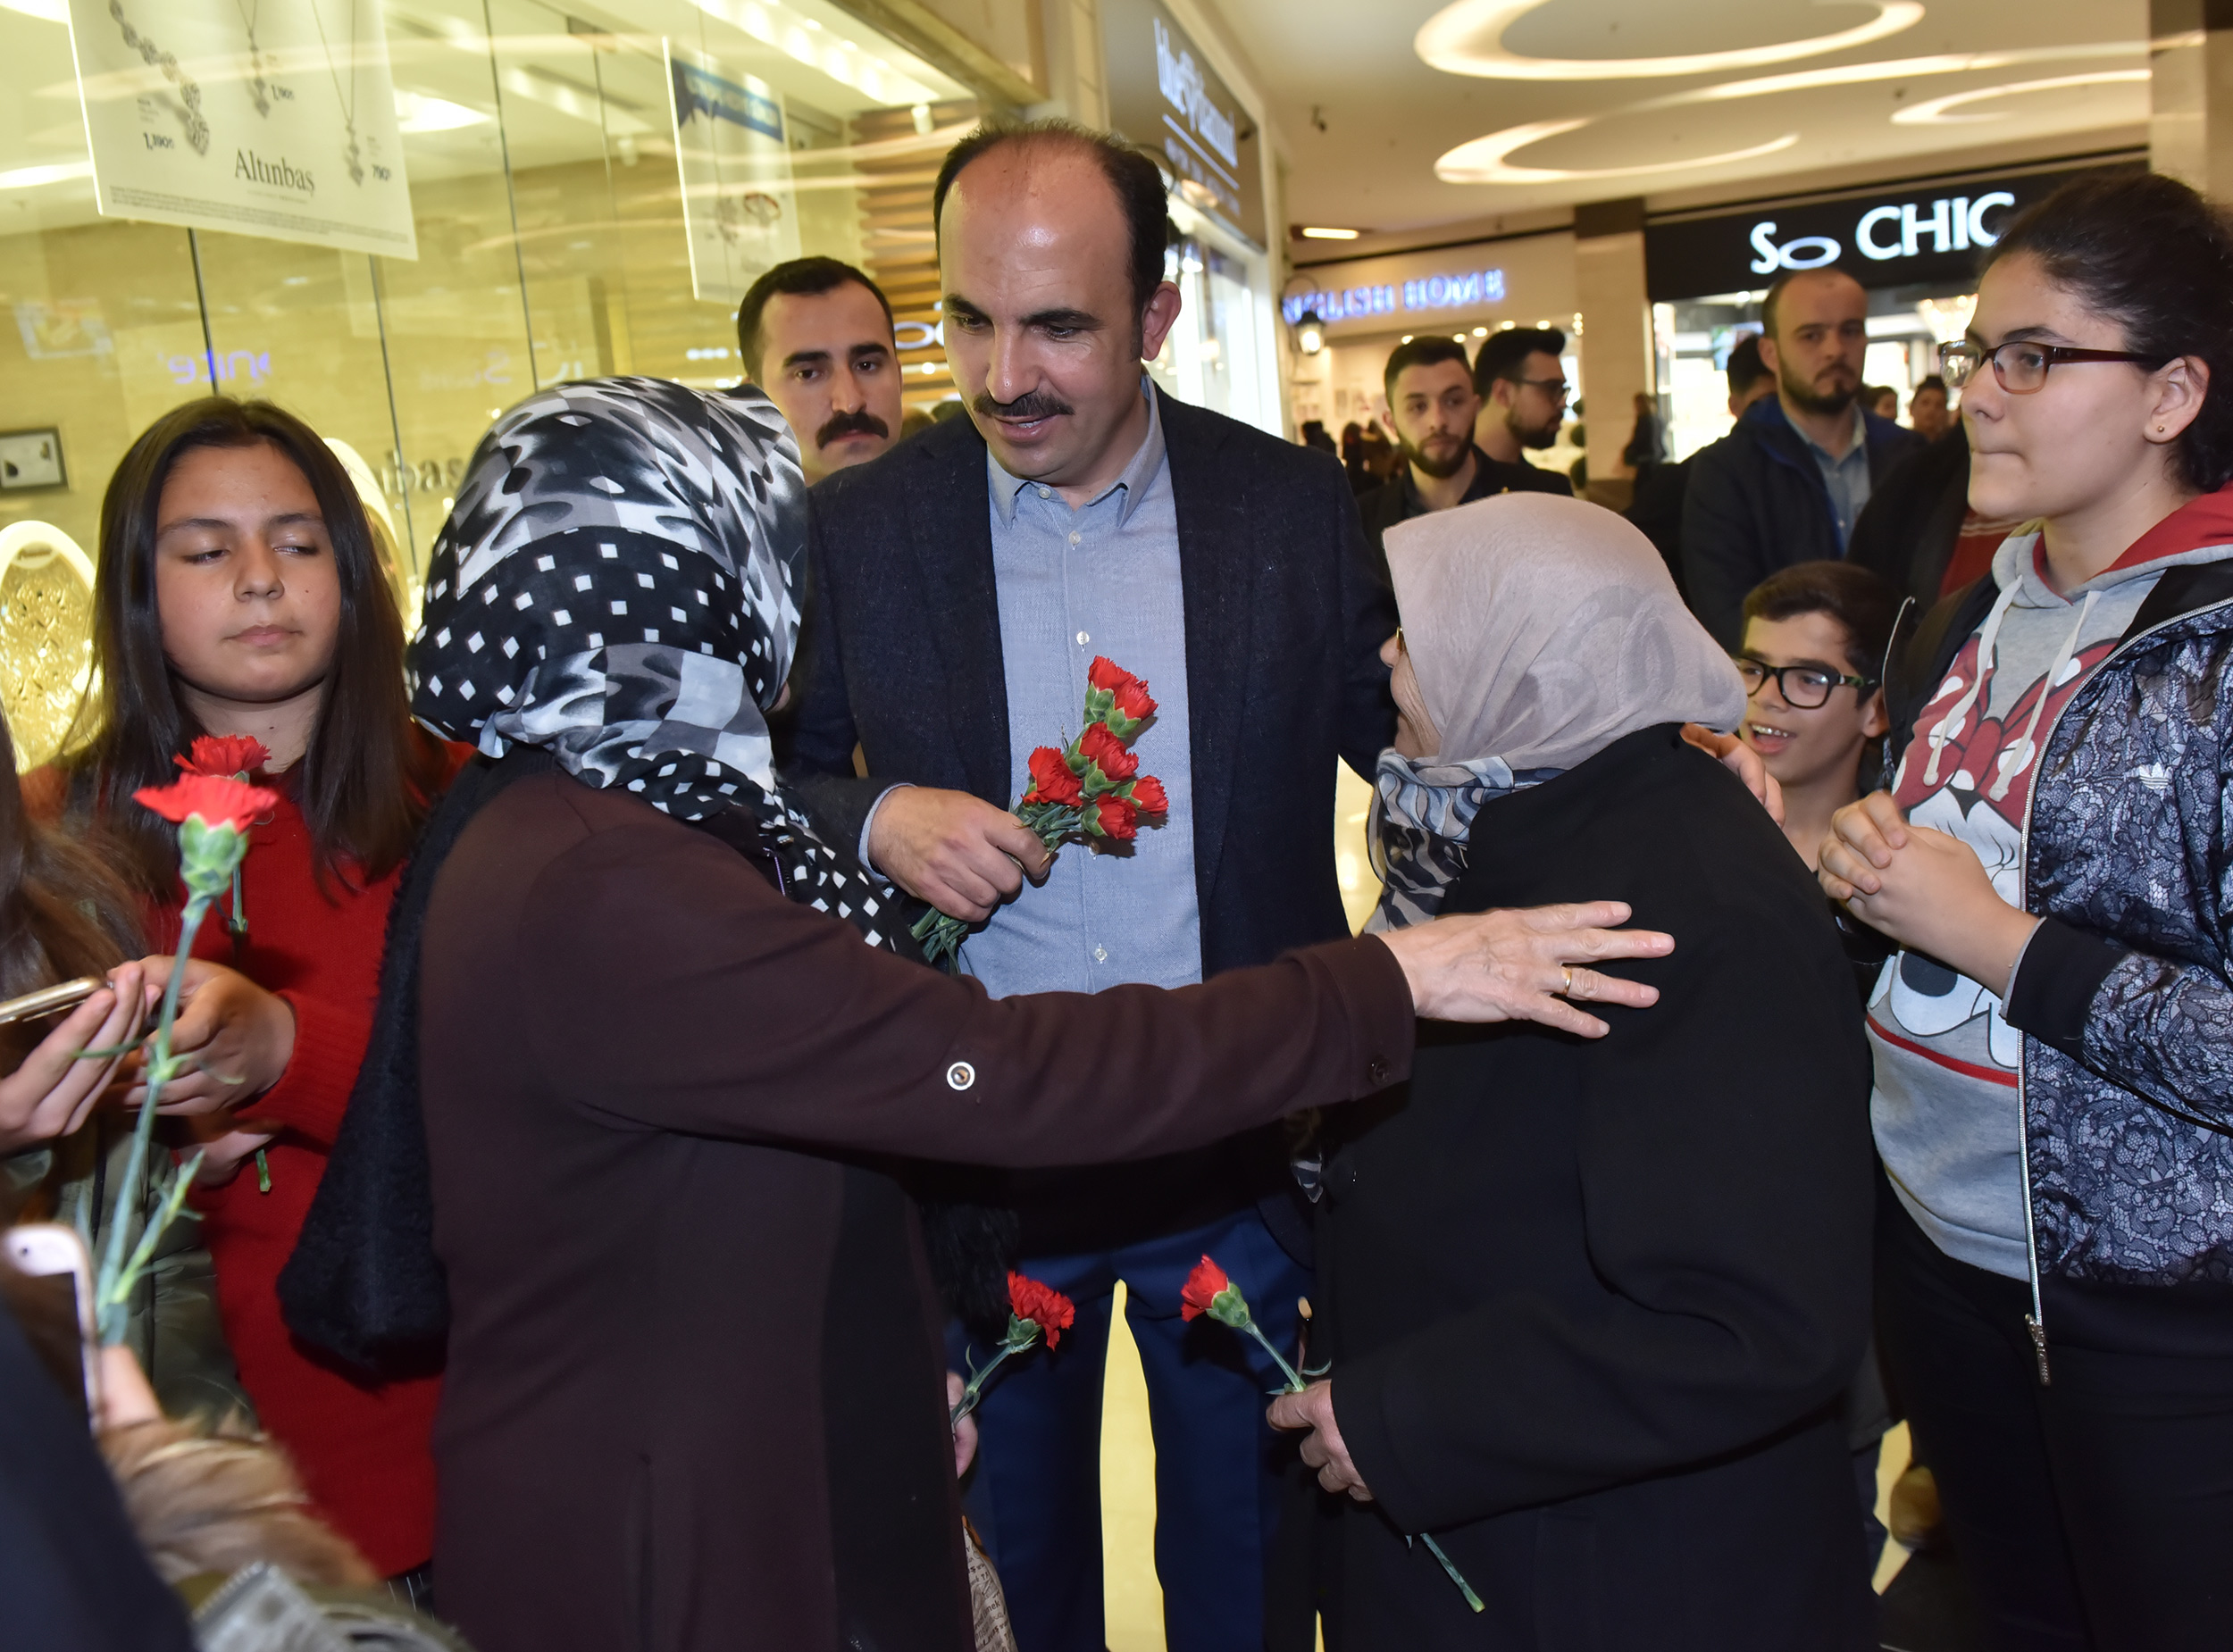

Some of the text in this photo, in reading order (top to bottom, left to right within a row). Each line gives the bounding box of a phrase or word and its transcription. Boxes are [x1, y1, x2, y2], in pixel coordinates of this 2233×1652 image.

[235, 147, 315, 198] Altınbaş
[1855, 191, 2015, 261] CHIC
[1282, 269, 1505, 323] NGLISH HOME
